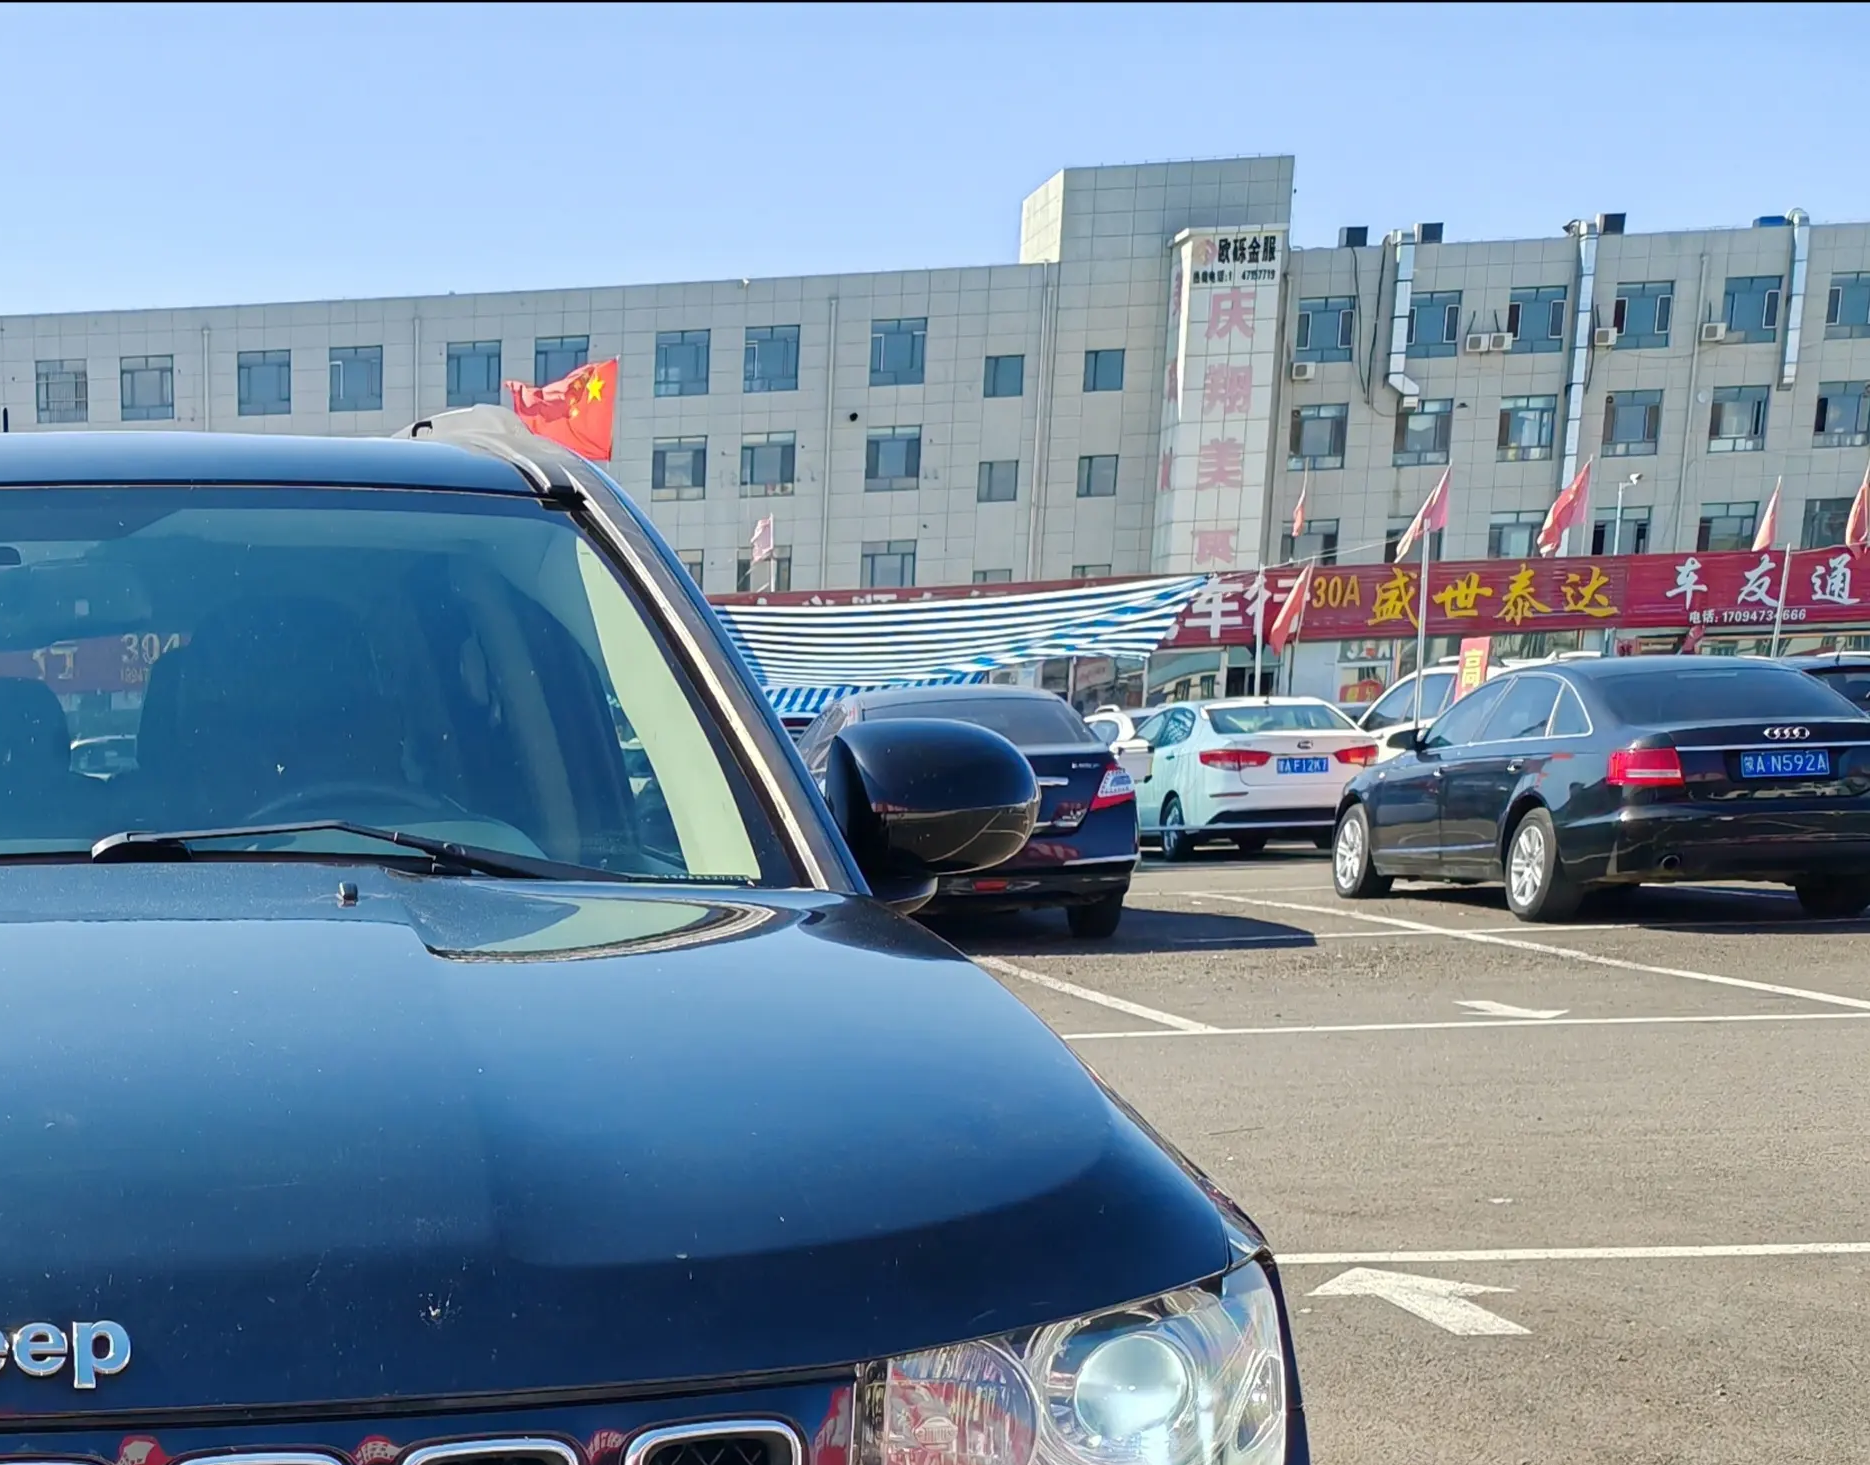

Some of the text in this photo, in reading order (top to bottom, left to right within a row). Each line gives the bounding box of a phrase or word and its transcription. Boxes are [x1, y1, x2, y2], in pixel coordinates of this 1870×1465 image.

[1367, 563, 1620, 629] 盛世泰达
[1665, 553, 1861, 611] 车友通
